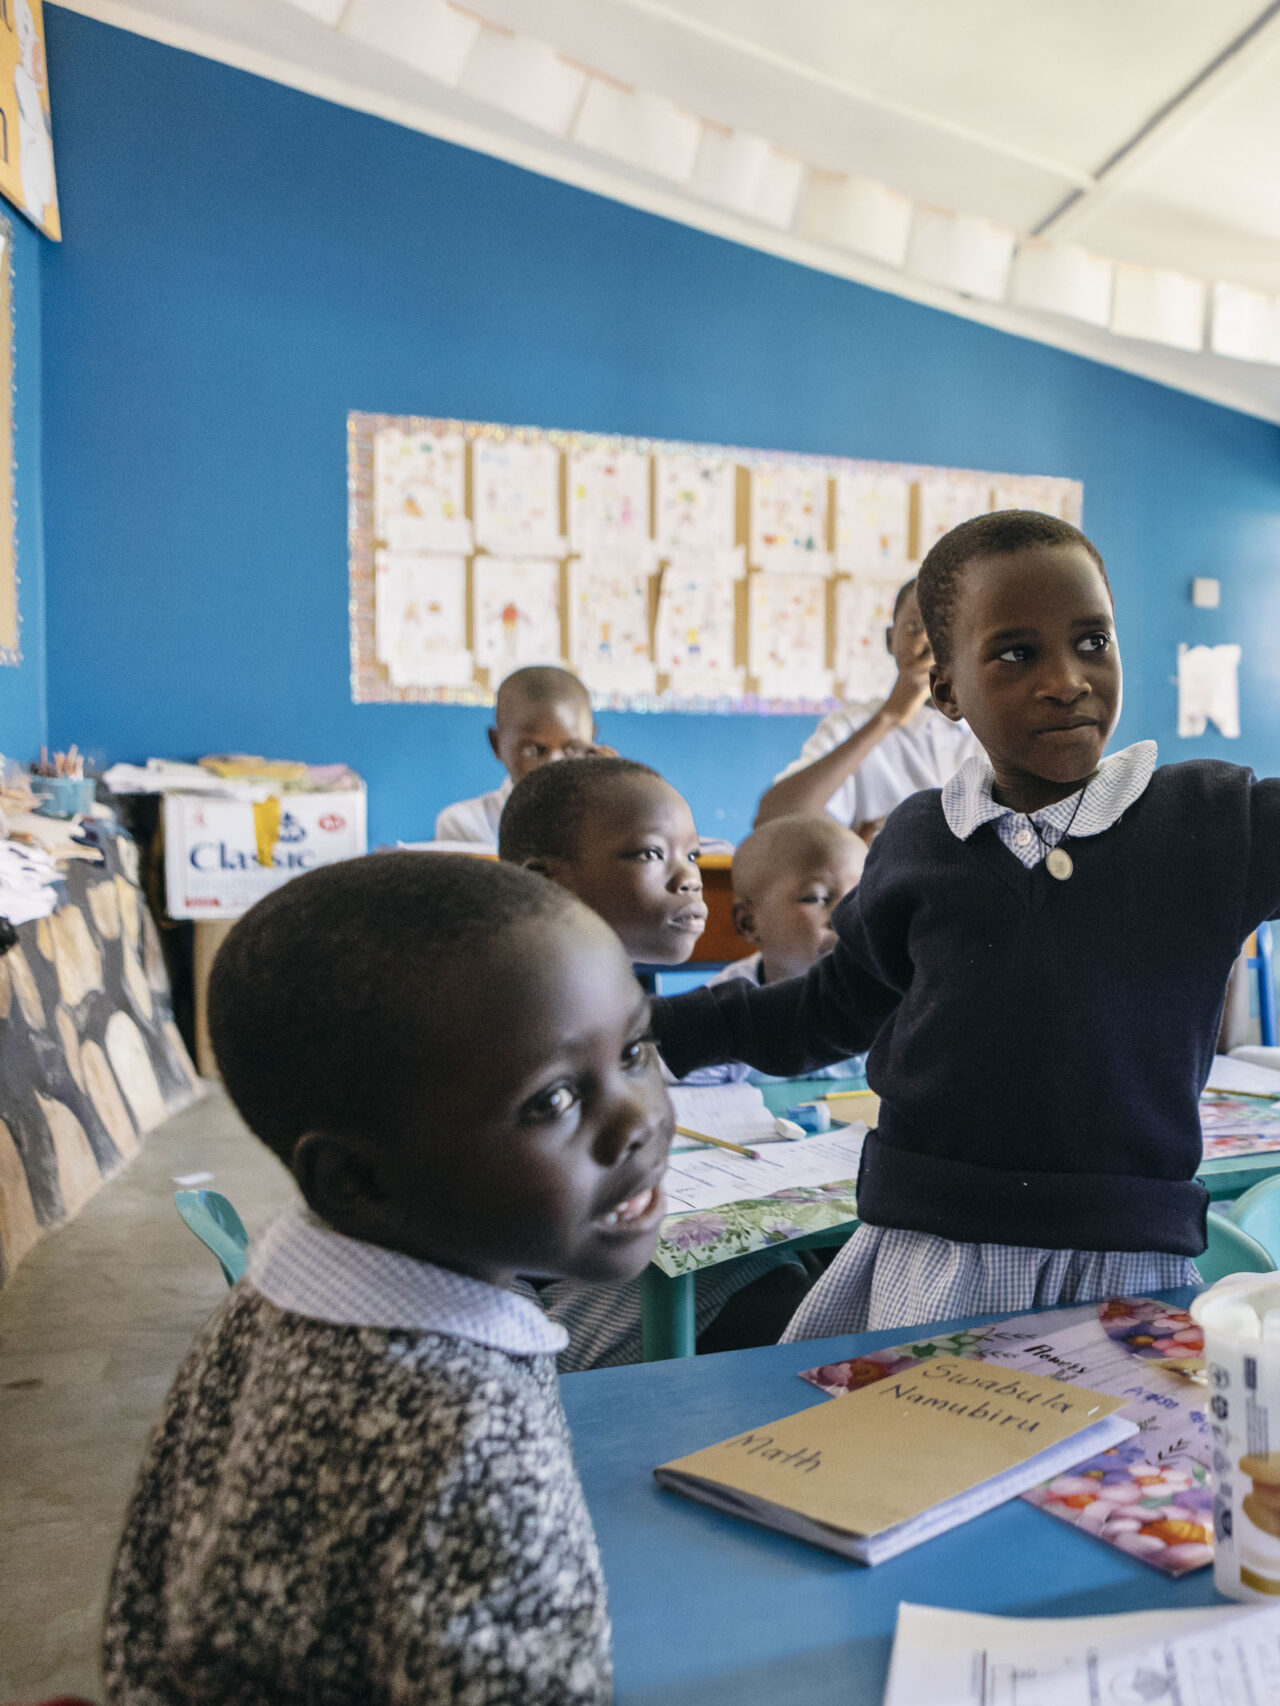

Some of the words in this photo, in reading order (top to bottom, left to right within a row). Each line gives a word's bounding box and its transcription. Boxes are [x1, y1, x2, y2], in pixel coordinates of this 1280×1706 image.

[1023, 1344, 1089, 1375] Flowers
[879, 1383, 1040, 1433] Namubiru
[725, 1433, 822, 1473] Math
